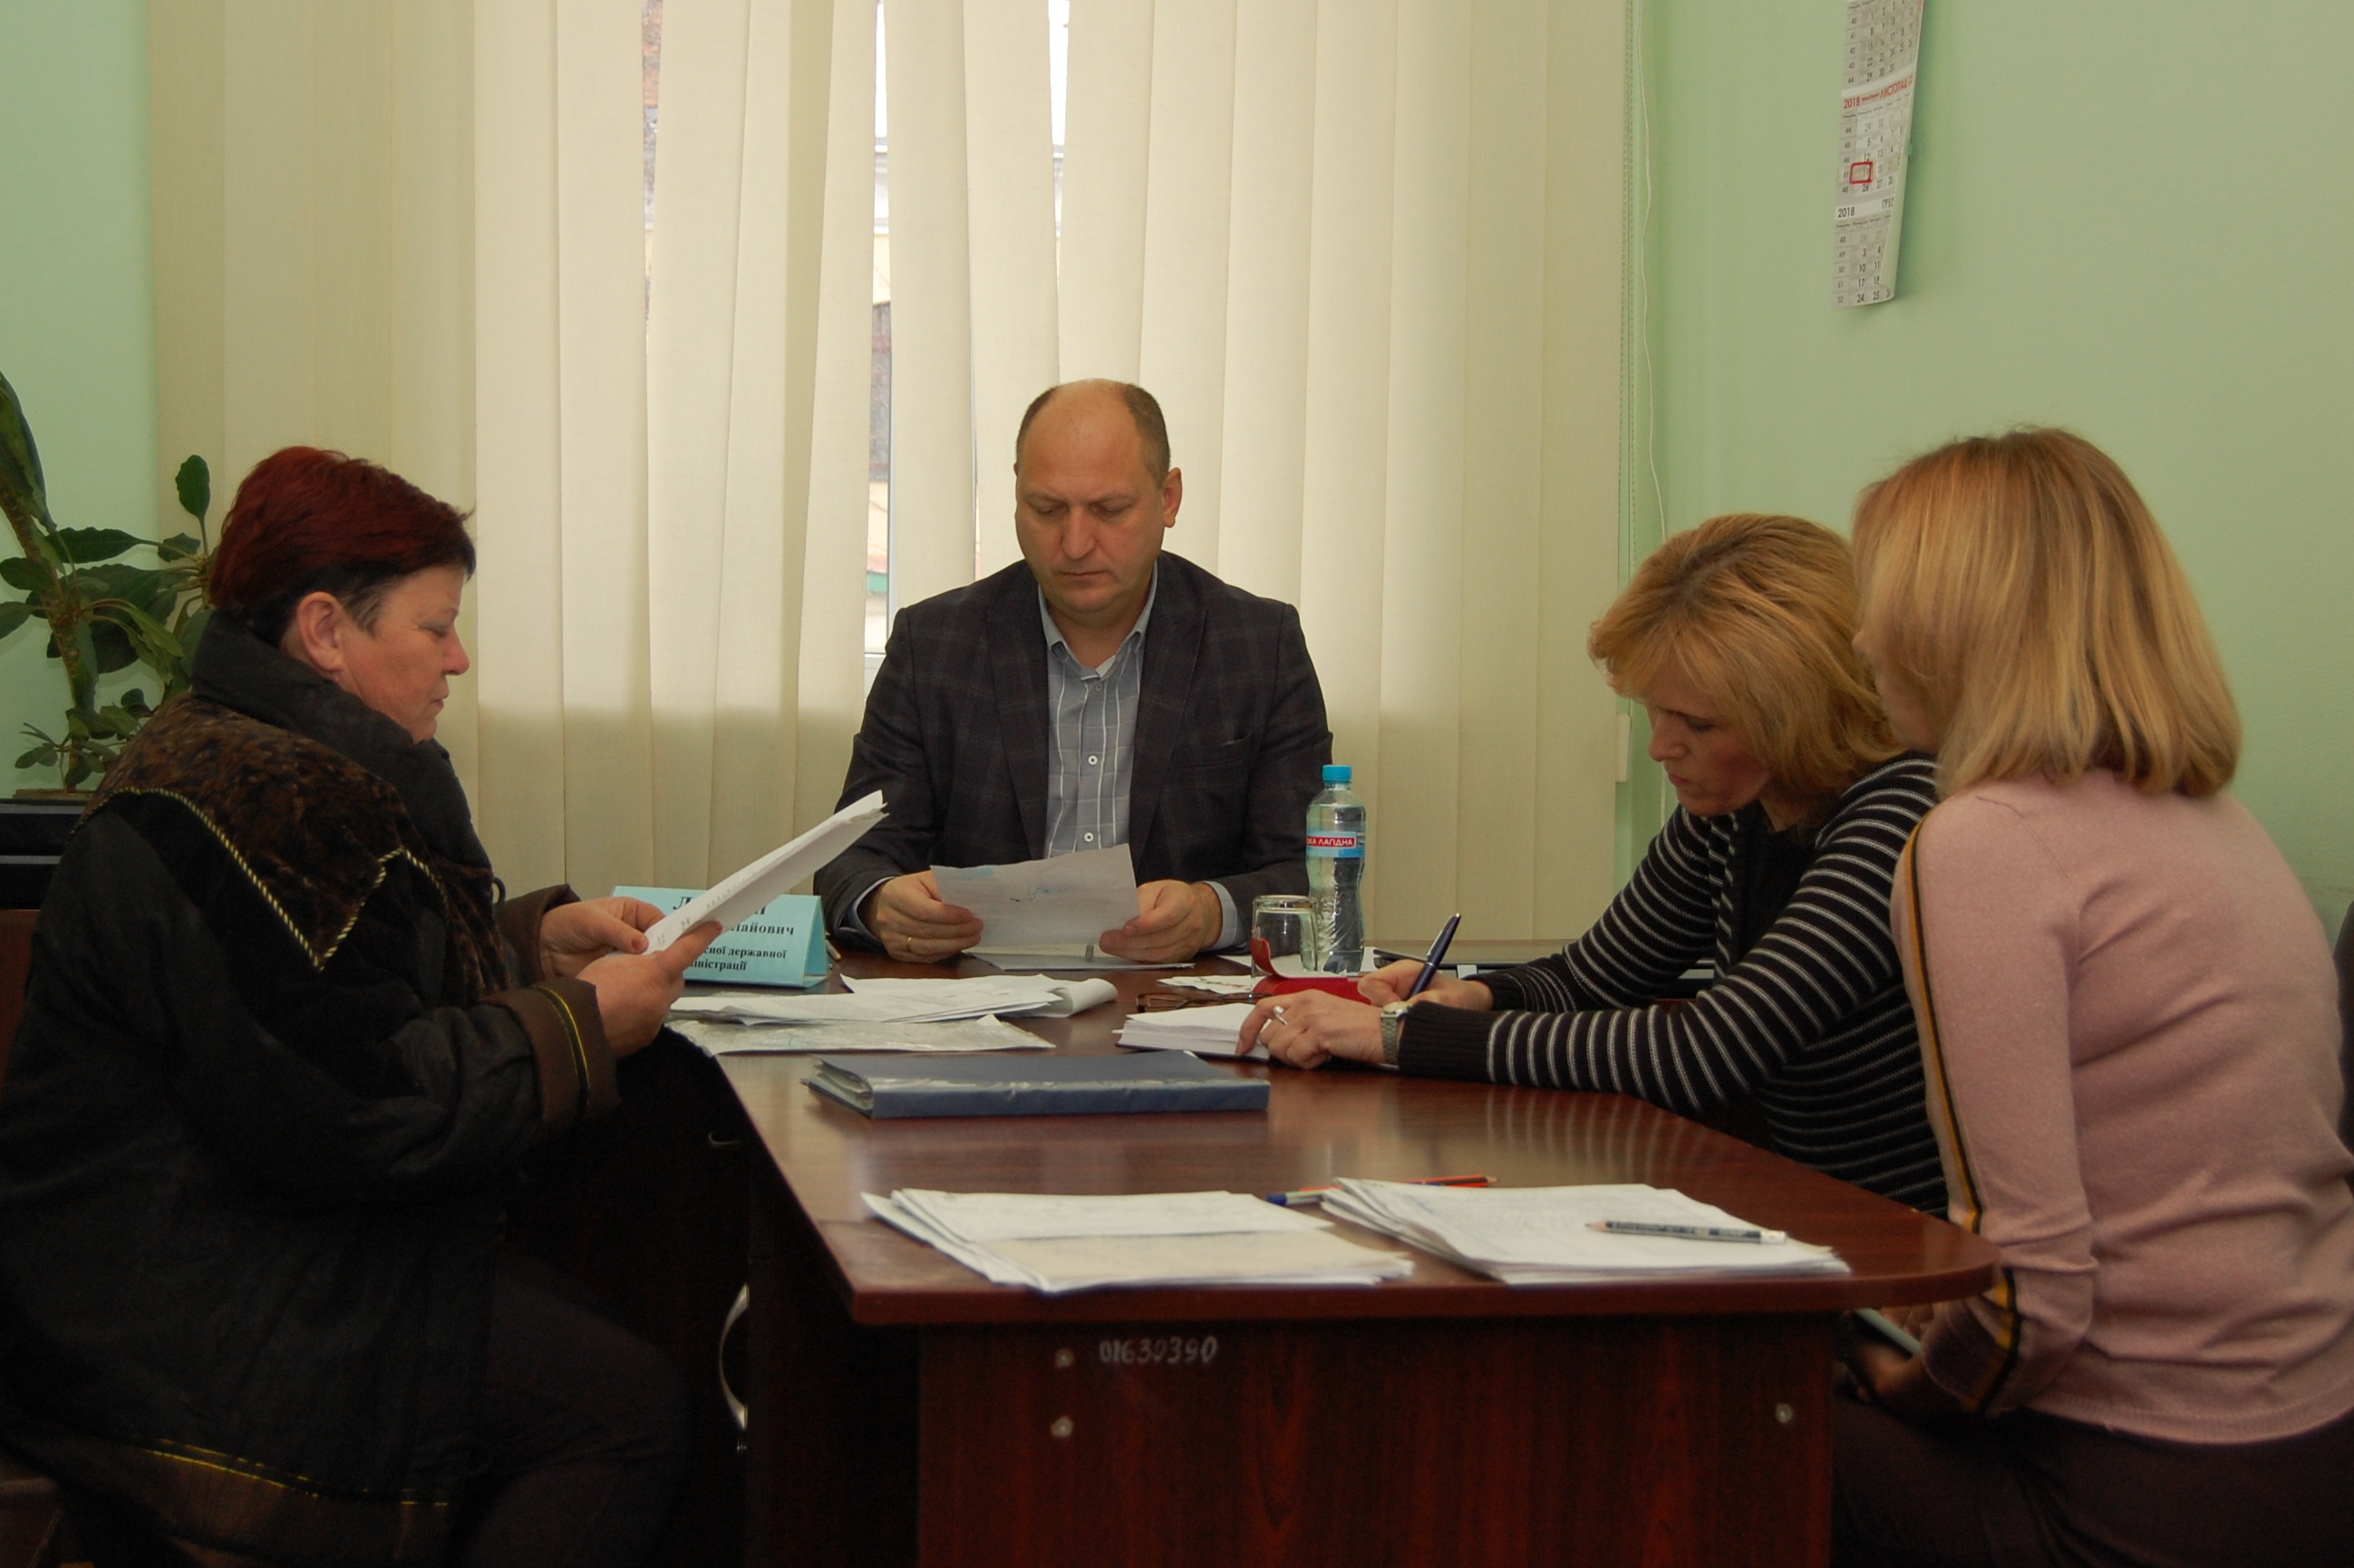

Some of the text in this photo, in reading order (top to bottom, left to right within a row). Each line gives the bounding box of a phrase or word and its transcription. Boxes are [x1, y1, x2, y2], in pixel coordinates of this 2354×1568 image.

[1843, 97, 1860, 109] 2018
[1837, 207, 1855, 218] 2018
[731, 922, 795, 935] лайович
[728, 948, 788, 959] державної
[689, 959, 748, 972] іністрації
